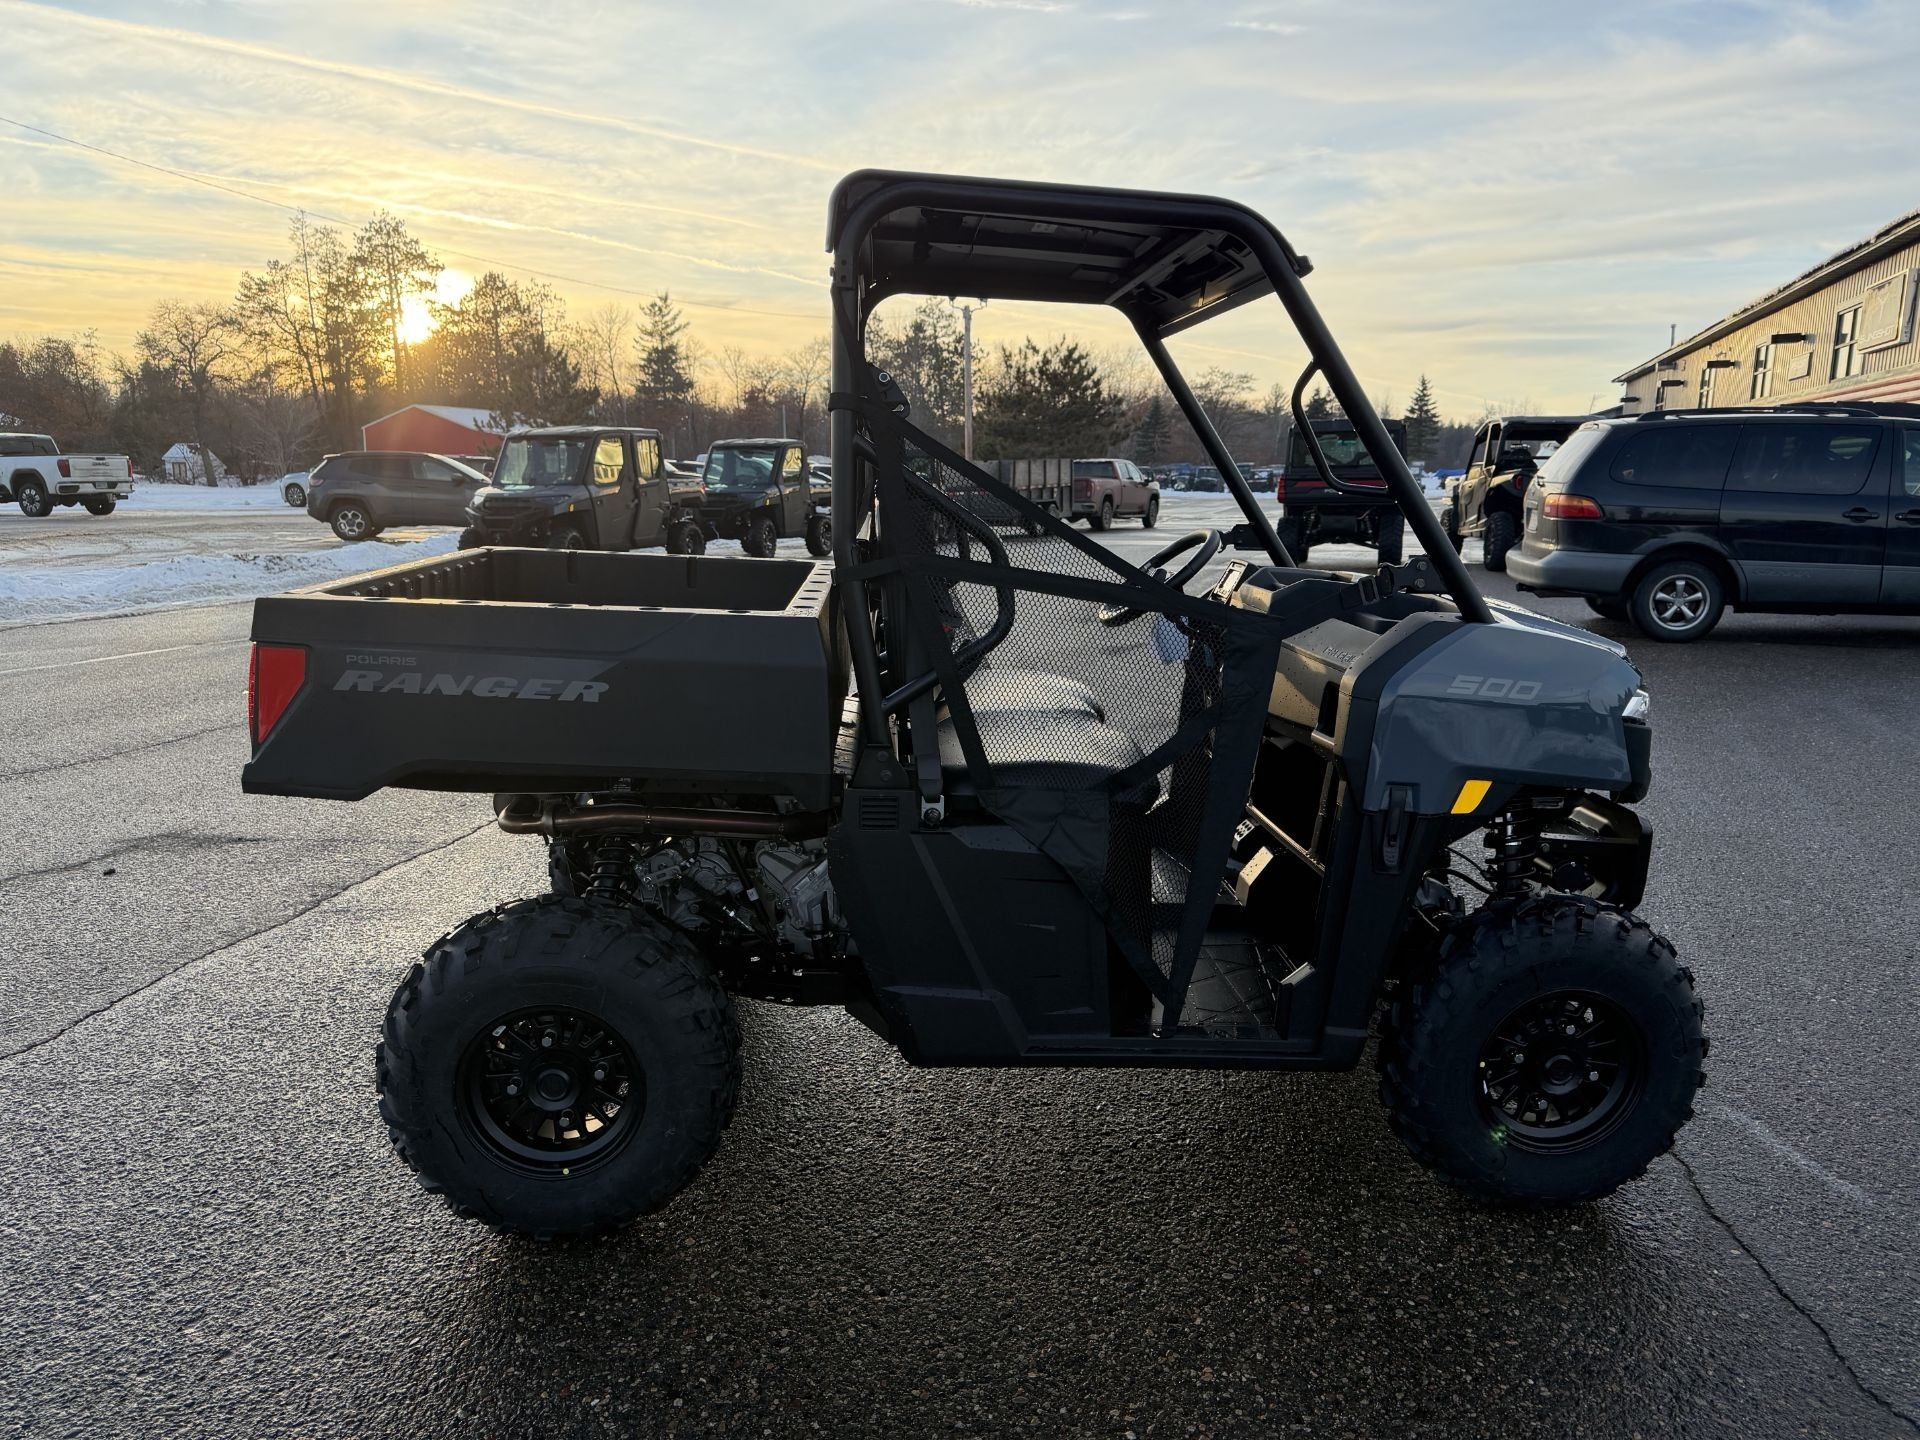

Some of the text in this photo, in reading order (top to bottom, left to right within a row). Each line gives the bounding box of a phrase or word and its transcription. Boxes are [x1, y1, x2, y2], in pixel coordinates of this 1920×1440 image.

[346, 655, 417, 666] POLARIS
[333, 670, 610, 703] RANGER
[1446, 674, 1543, 700] 500
